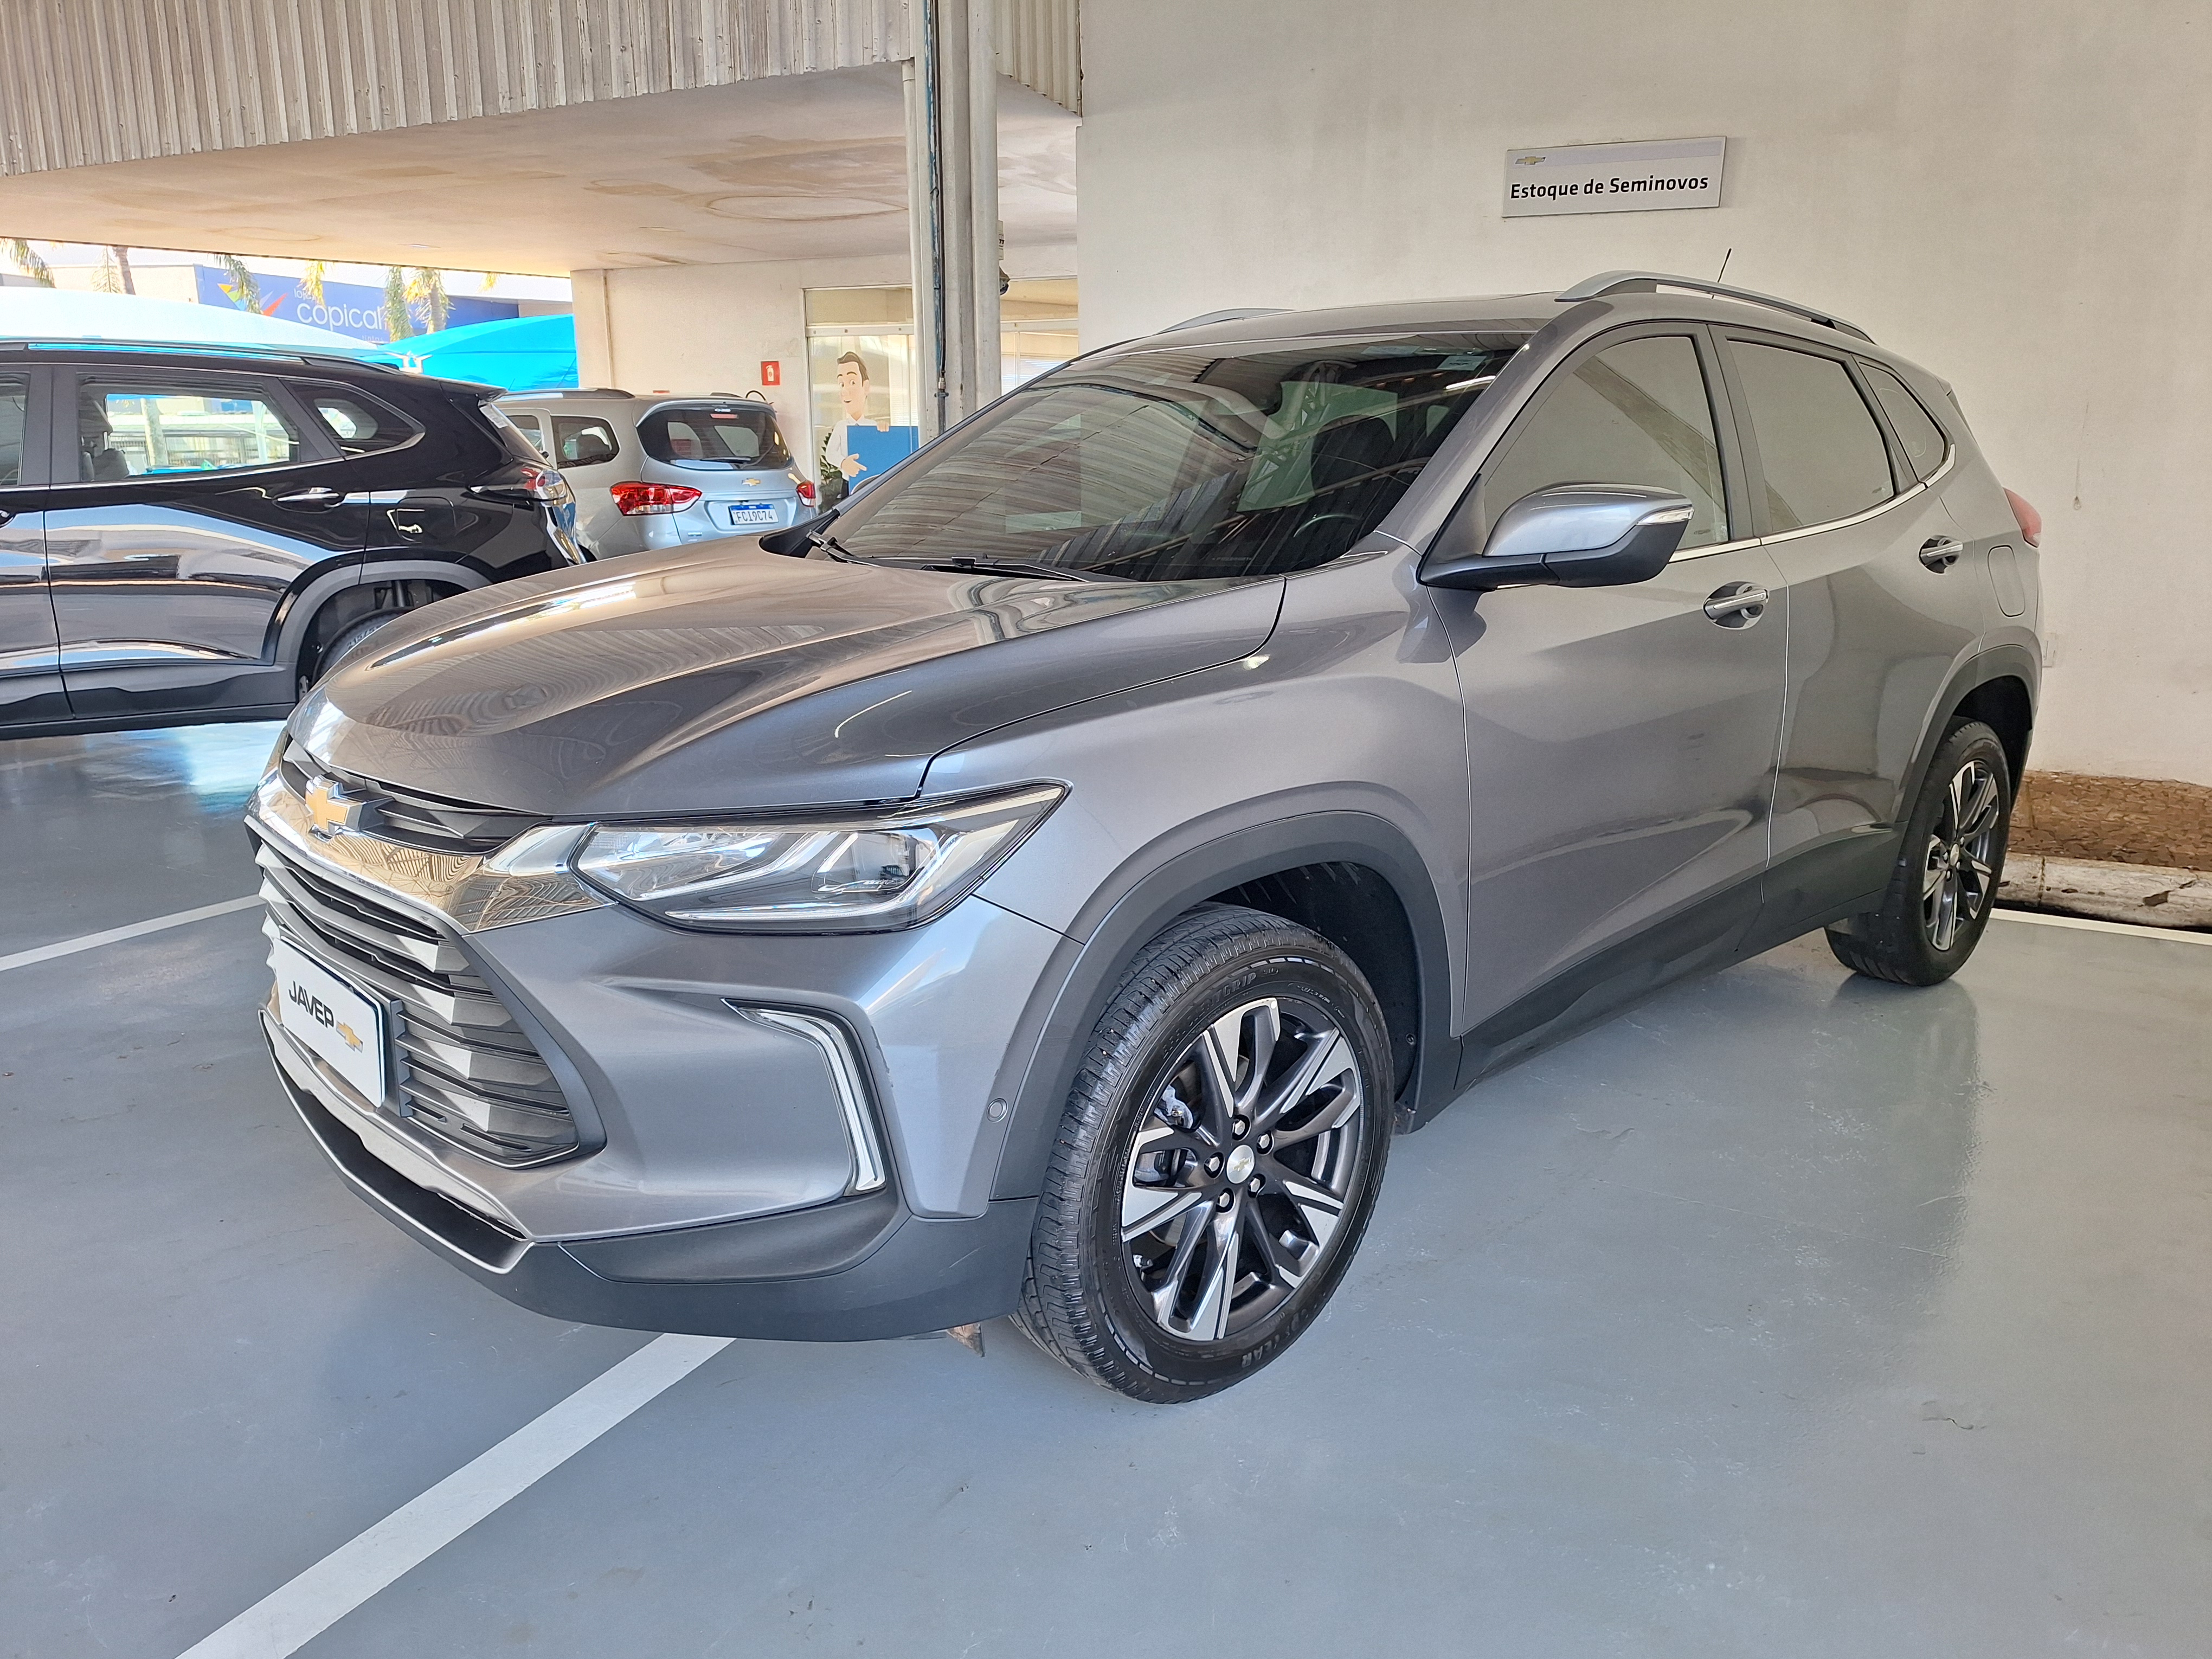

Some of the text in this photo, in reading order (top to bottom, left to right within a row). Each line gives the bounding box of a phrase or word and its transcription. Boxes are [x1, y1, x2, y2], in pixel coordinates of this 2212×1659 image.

[1510, 175, 1709, 201] Estoque de Seminovos
[288, 980, 335, 1029] JAVEP
